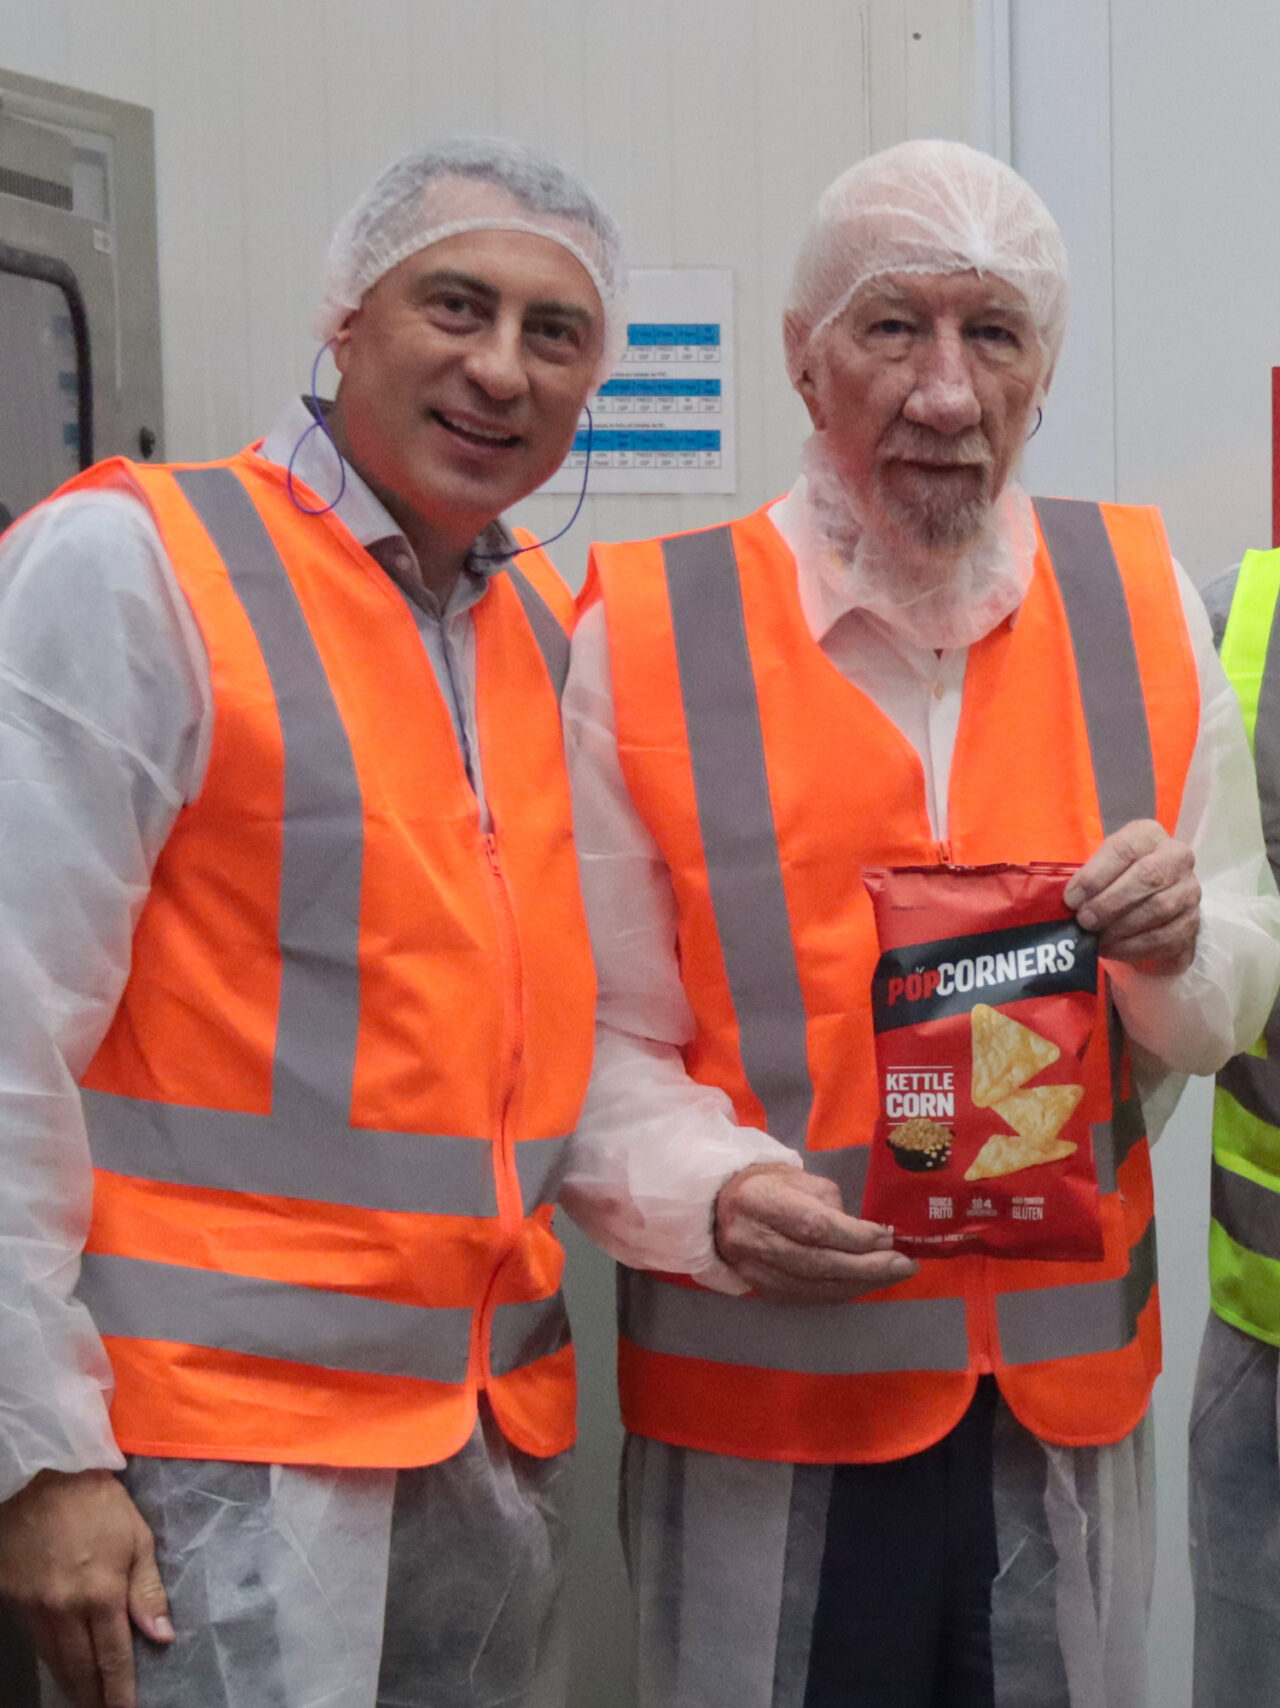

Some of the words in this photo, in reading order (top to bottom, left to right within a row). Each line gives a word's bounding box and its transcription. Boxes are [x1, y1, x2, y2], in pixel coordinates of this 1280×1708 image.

[888, 939, 1076, 1006] POPCORNERS
[886, 1072, 955, 1091] KETTLE
[886, 1092, 955, 1118] CORN
[984, 1199, 992, 1209] 4
[928, 1207, 953, 1220] FRITO
[1012, 1206, 1043, 1220] GLUTEN
